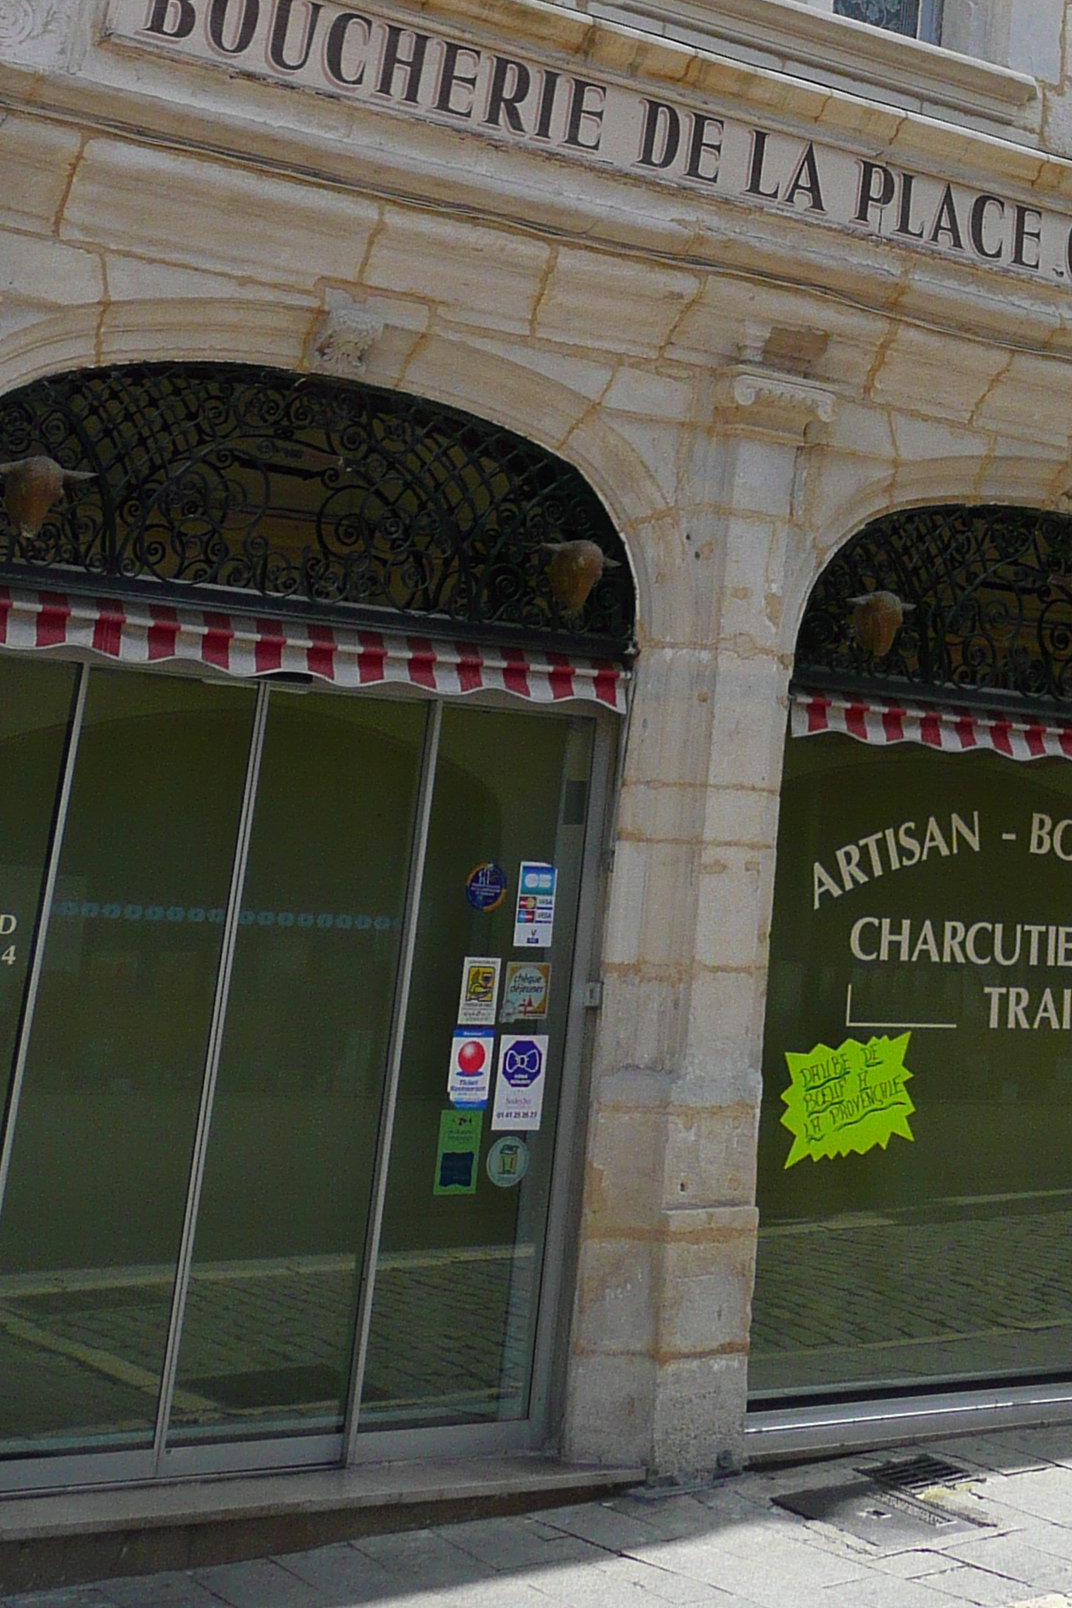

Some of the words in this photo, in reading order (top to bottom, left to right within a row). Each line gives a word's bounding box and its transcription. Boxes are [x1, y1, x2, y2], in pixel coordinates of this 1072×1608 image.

[638, 98, 725, 184] DE
[746, 130, 826, 213] LA
[854, 158, 1042, 270] PLACE
[812, 810, 981, 911] ARTISAN
[861, 1044, 881, 1065] DE
